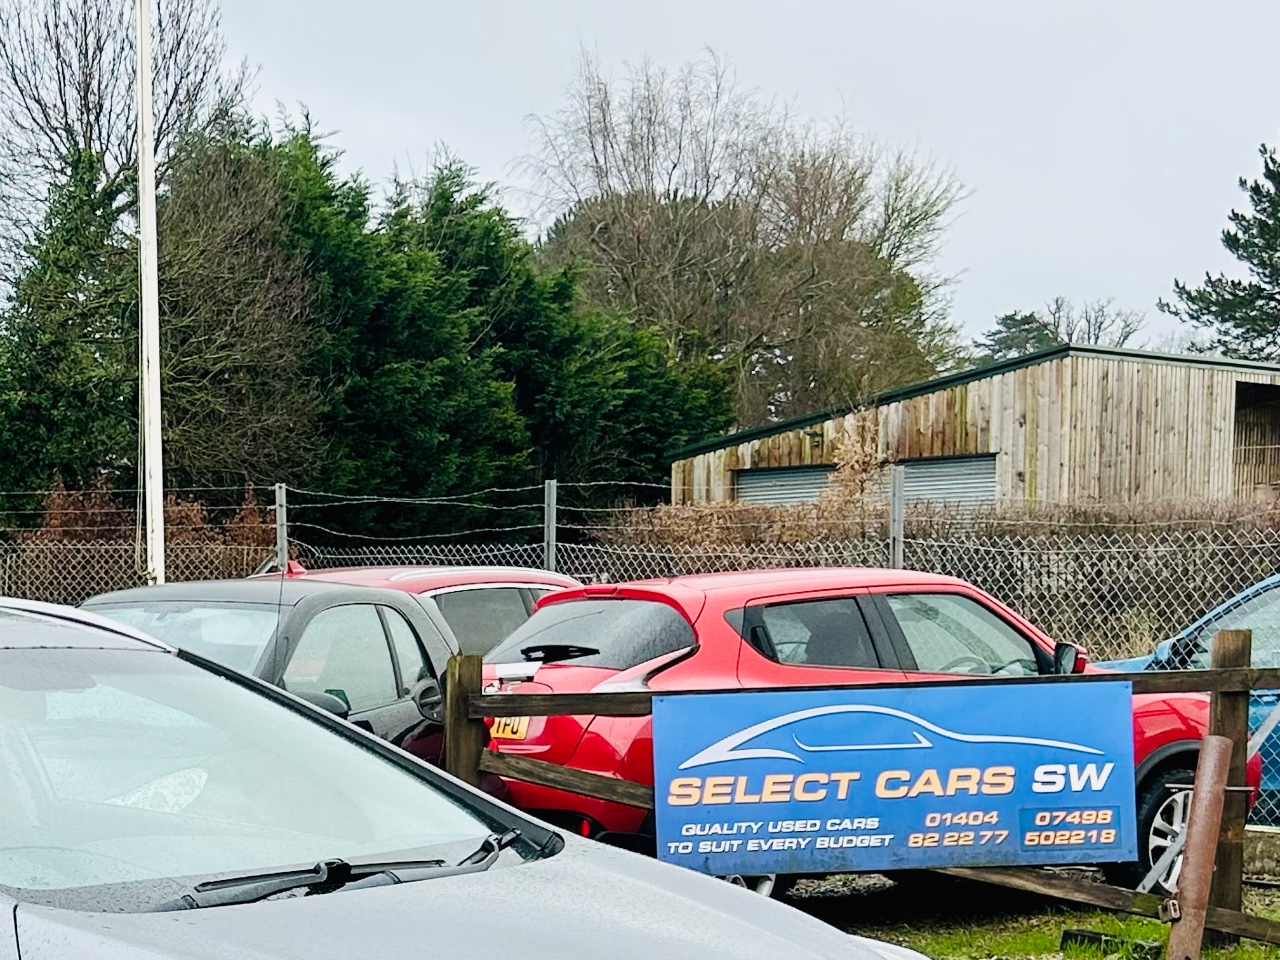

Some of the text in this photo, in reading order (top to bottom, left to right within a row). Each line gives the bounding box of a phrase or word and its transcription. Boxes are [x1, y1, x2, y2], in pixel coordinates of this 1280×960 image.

[667, 762, 1115, 807] SELECT CARS SW
[681, 817, 880, 836] QUALITY USED CARS
[924, 811, 999, 828] 01404
[1034, 810, 1113, 826] 07498
[667, 834, 895, 855] TO SUIT EVERY BUDGET
[1023, 829, 1116, 846] 502218
